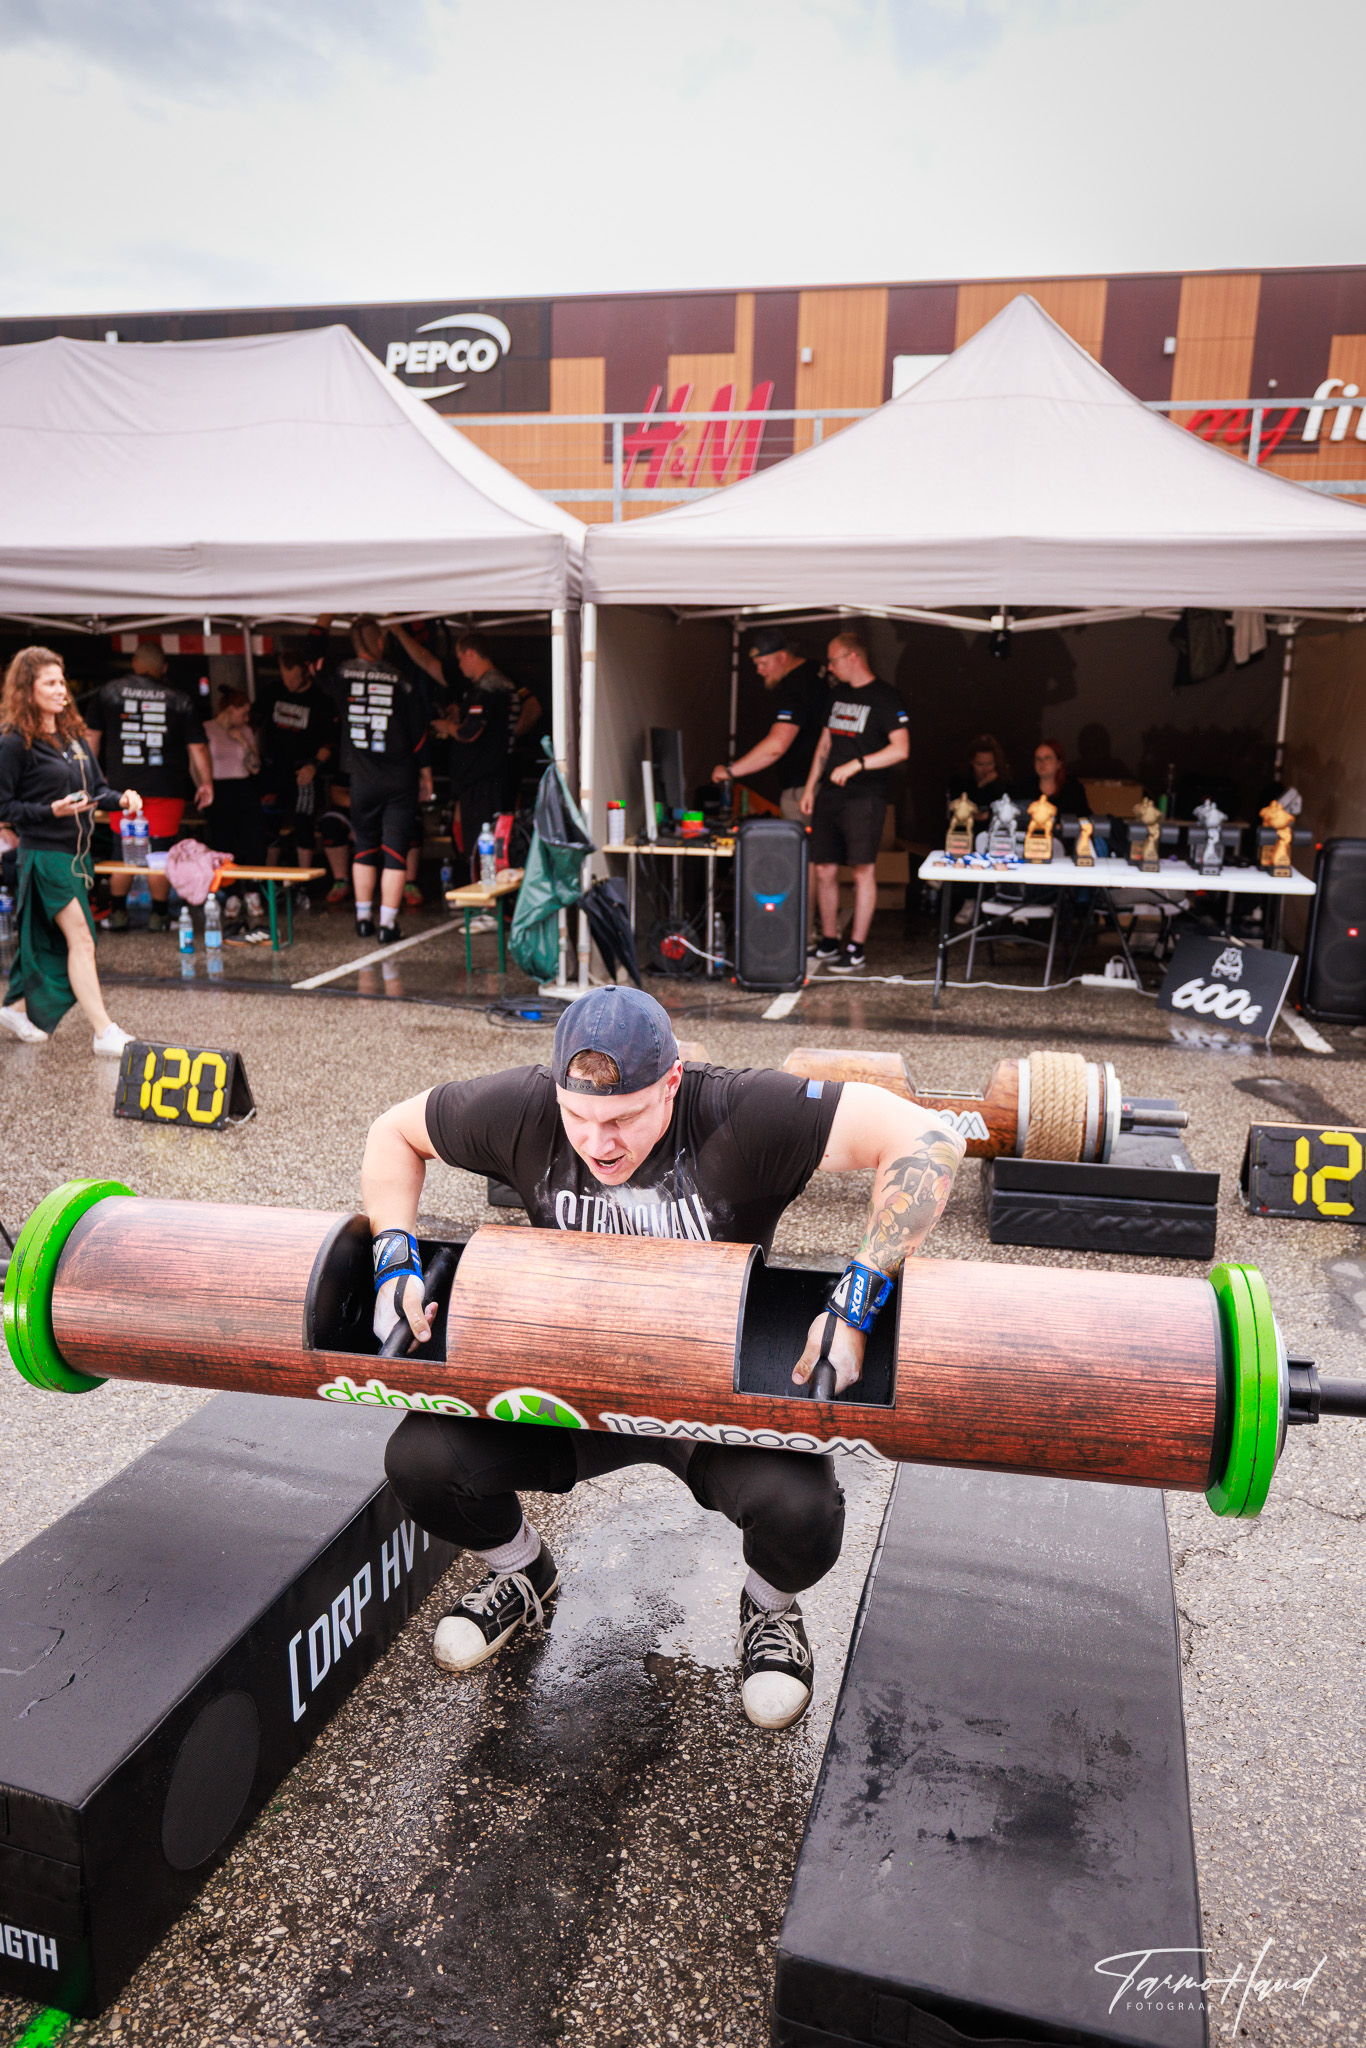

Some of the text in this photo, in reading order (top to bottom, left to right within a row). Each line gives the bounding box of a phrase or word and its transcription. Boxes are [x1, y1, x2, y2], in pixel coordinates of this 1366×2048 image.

[386, 338, 499, 374] PEPCO
[623, 379, 775, 489] H&M
[140, 1047, 227, 1124] 120
[850, 1273, 865, 1317] RDX
[325, 1381, 885, 1460] Woodwell Grupp
